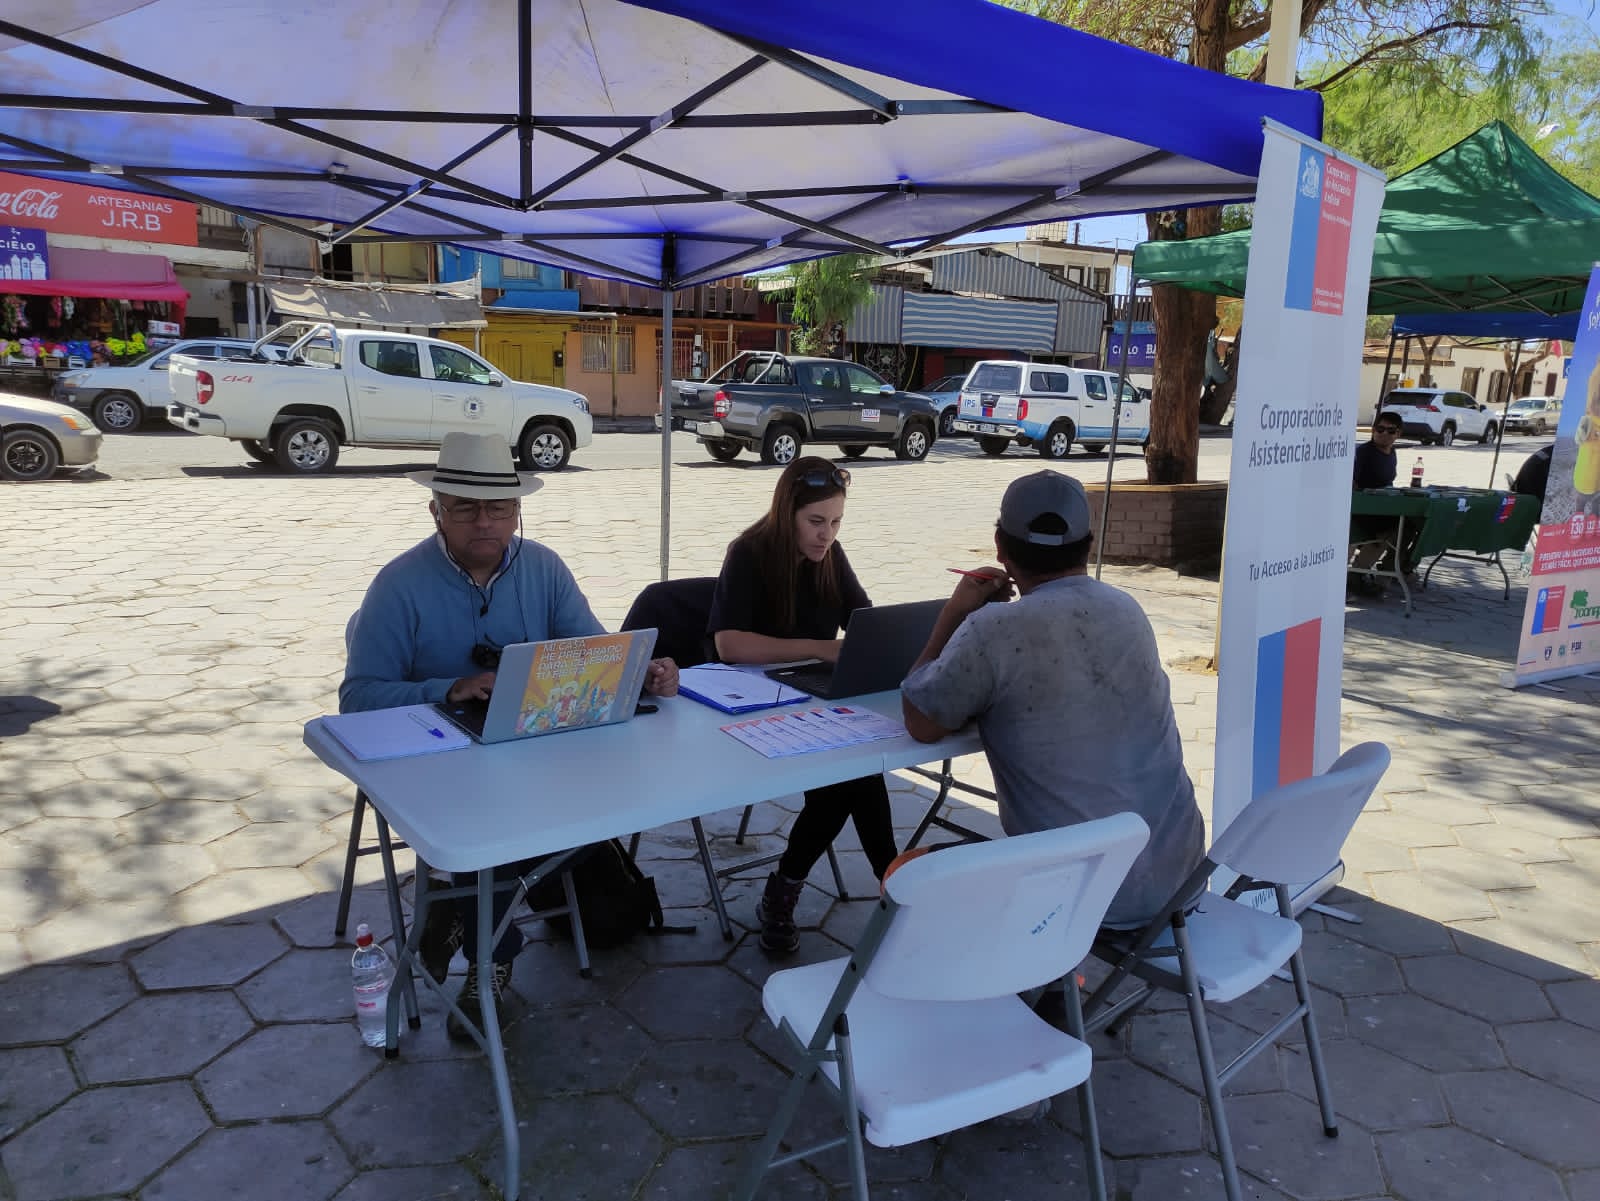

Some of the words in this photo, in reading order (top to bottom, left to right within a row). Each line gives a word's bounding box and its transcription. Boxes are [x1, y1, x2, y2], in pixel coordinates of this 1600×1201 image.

[88, 195, 173, 214] ARTESANIAS
[102, 210, 161, 232] J.R.B
[1112, 344, 1139, 355] CILO
[965, 399, 976, 408] IPS
[1260, 402, 1332, 435] Corporación
[1333, 402, 1343, 428] de
[1249, 438, 1311, 468] Asistencia
[1313, 434, 1348, 461] Judicial
[1250, 563, 1260, 581] Tu
[1261, 557, 1292, 579] Acceso
[1293, 558, 1299, 571] a
[1300, 553, 1307, 569] la
[1309, 544, 1335, 567] Justicia
